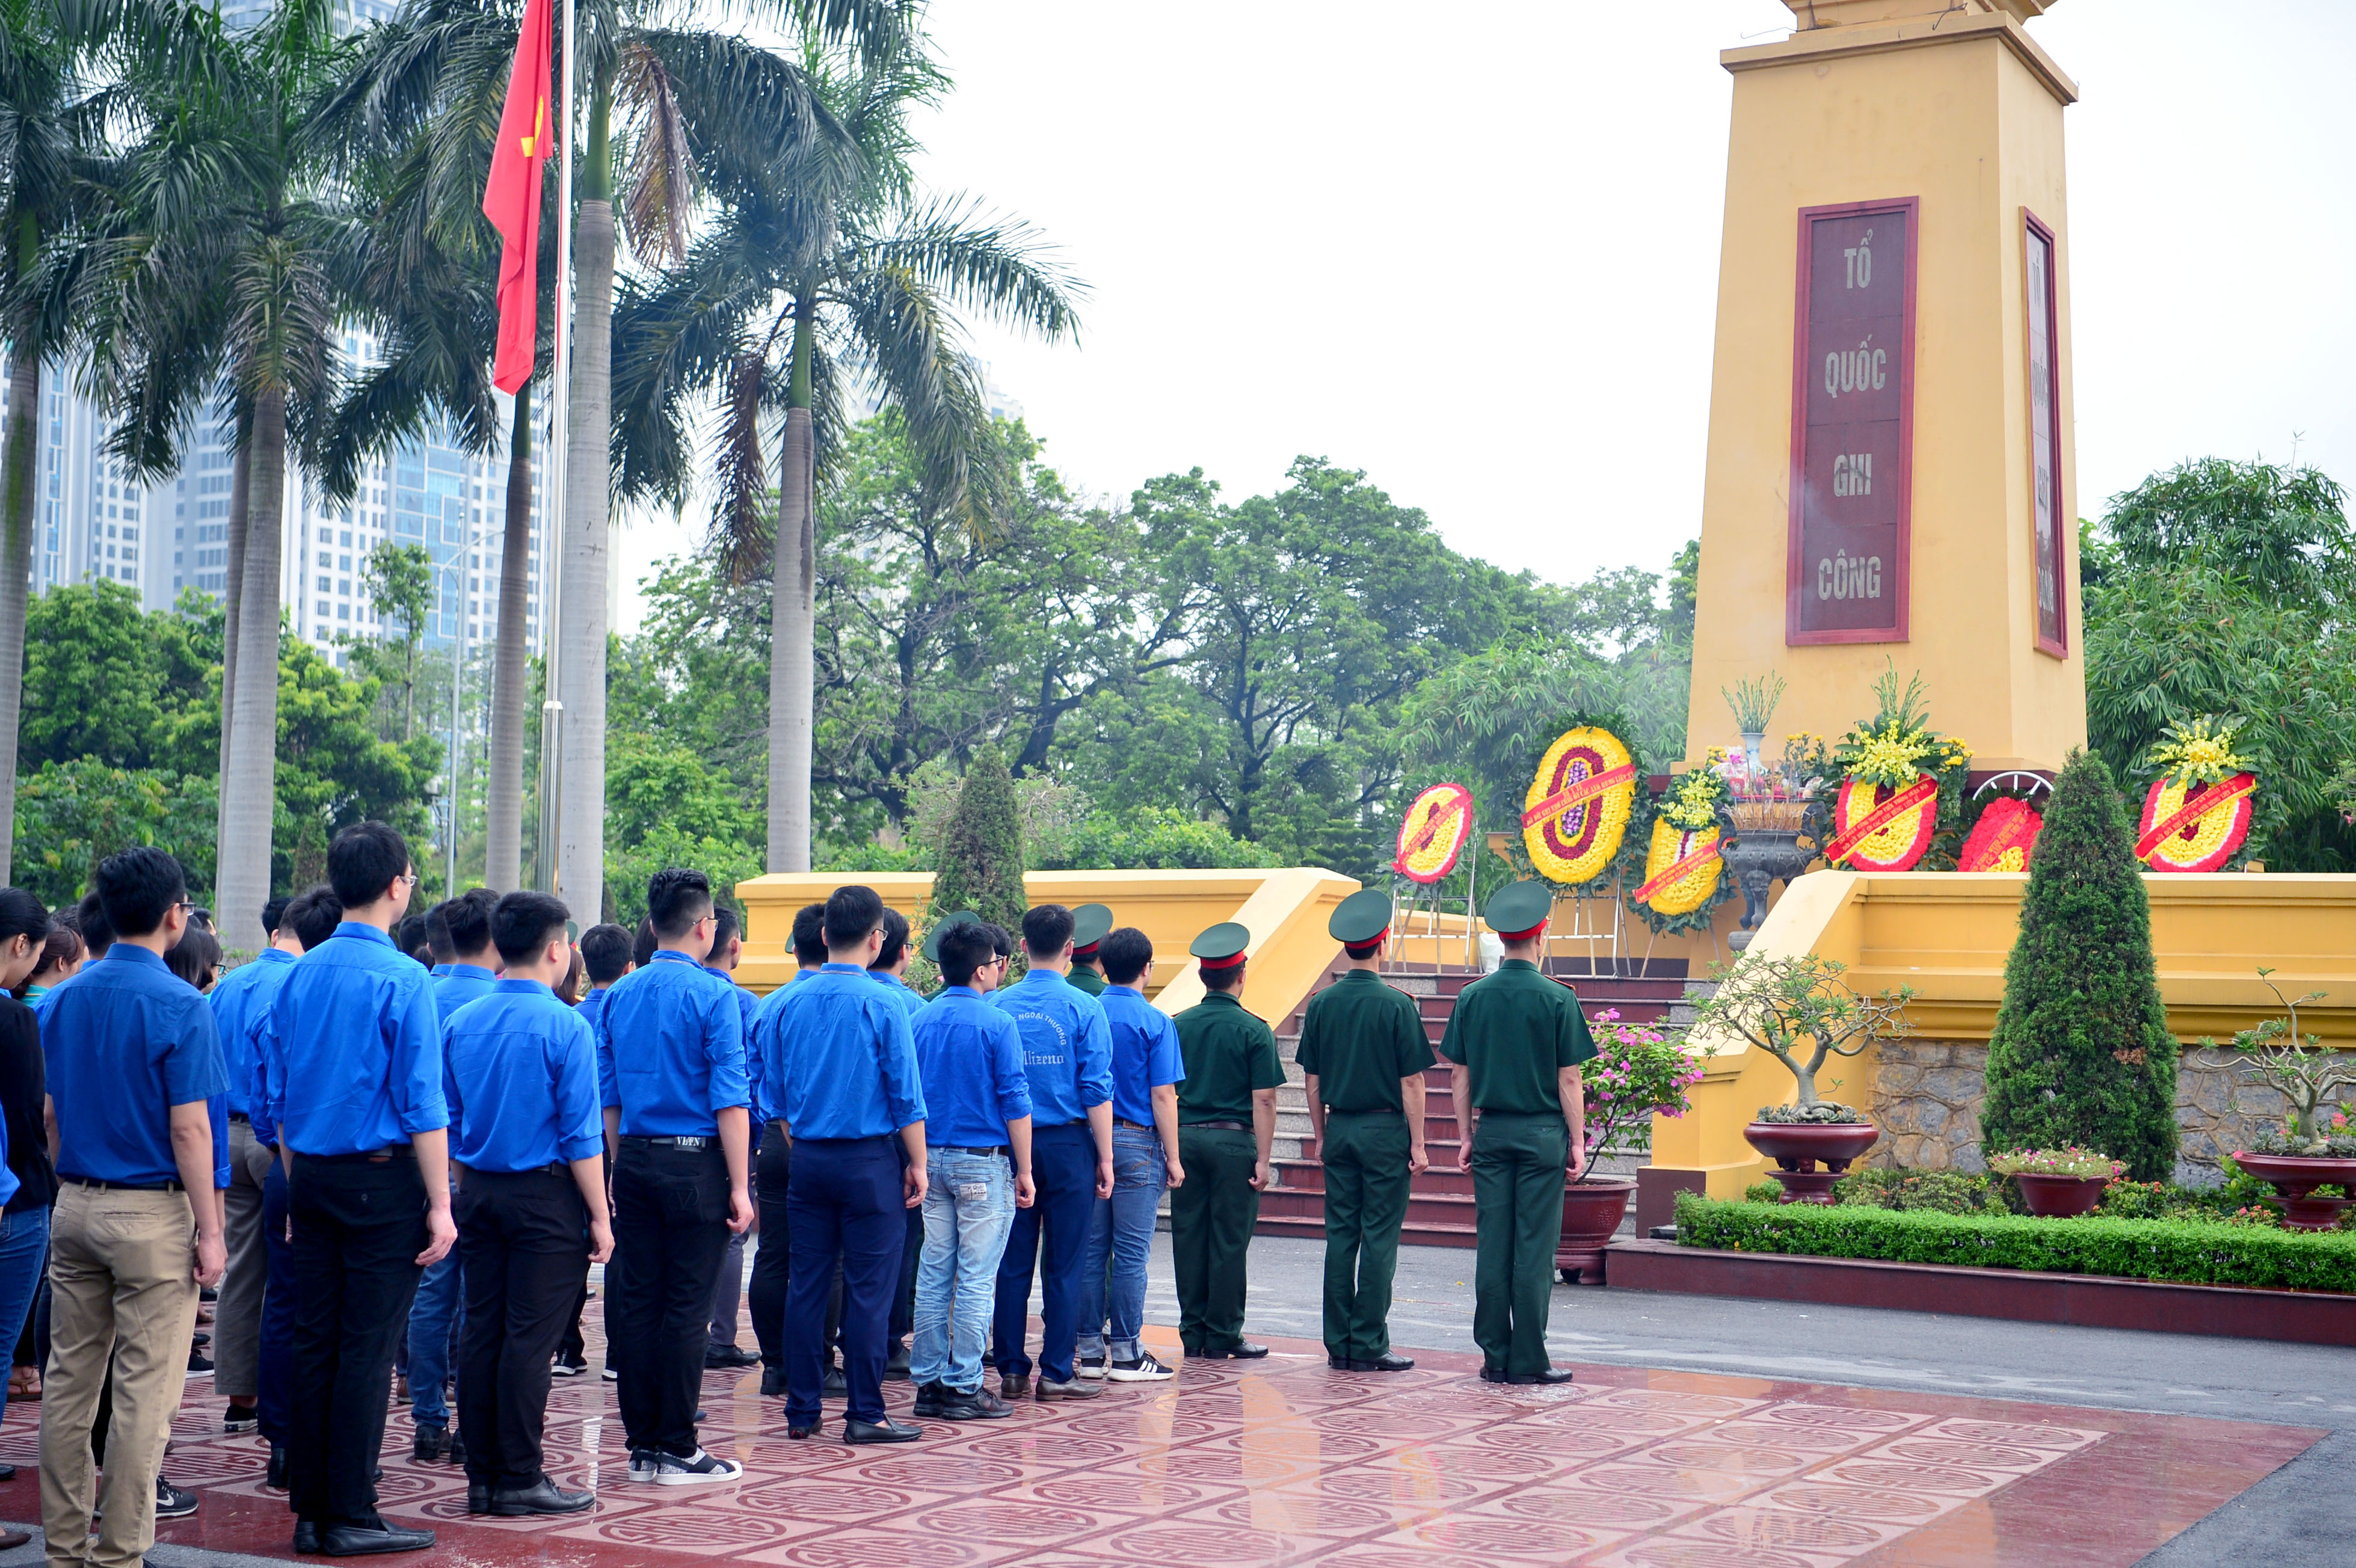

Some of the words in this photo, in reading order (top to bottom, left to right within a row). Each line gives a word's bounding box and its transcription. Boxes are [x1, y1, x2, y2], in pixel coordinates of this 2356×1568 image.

[1844, 229, 1873, 289] TỔ
[1825, 334, 1886, 398] QUỐC
[1834, 453, 1872, 497] GHI
[1818, 548, 1881, 600] CÔNG
[1018, 1012, 1044, 1020] NGOẠI
